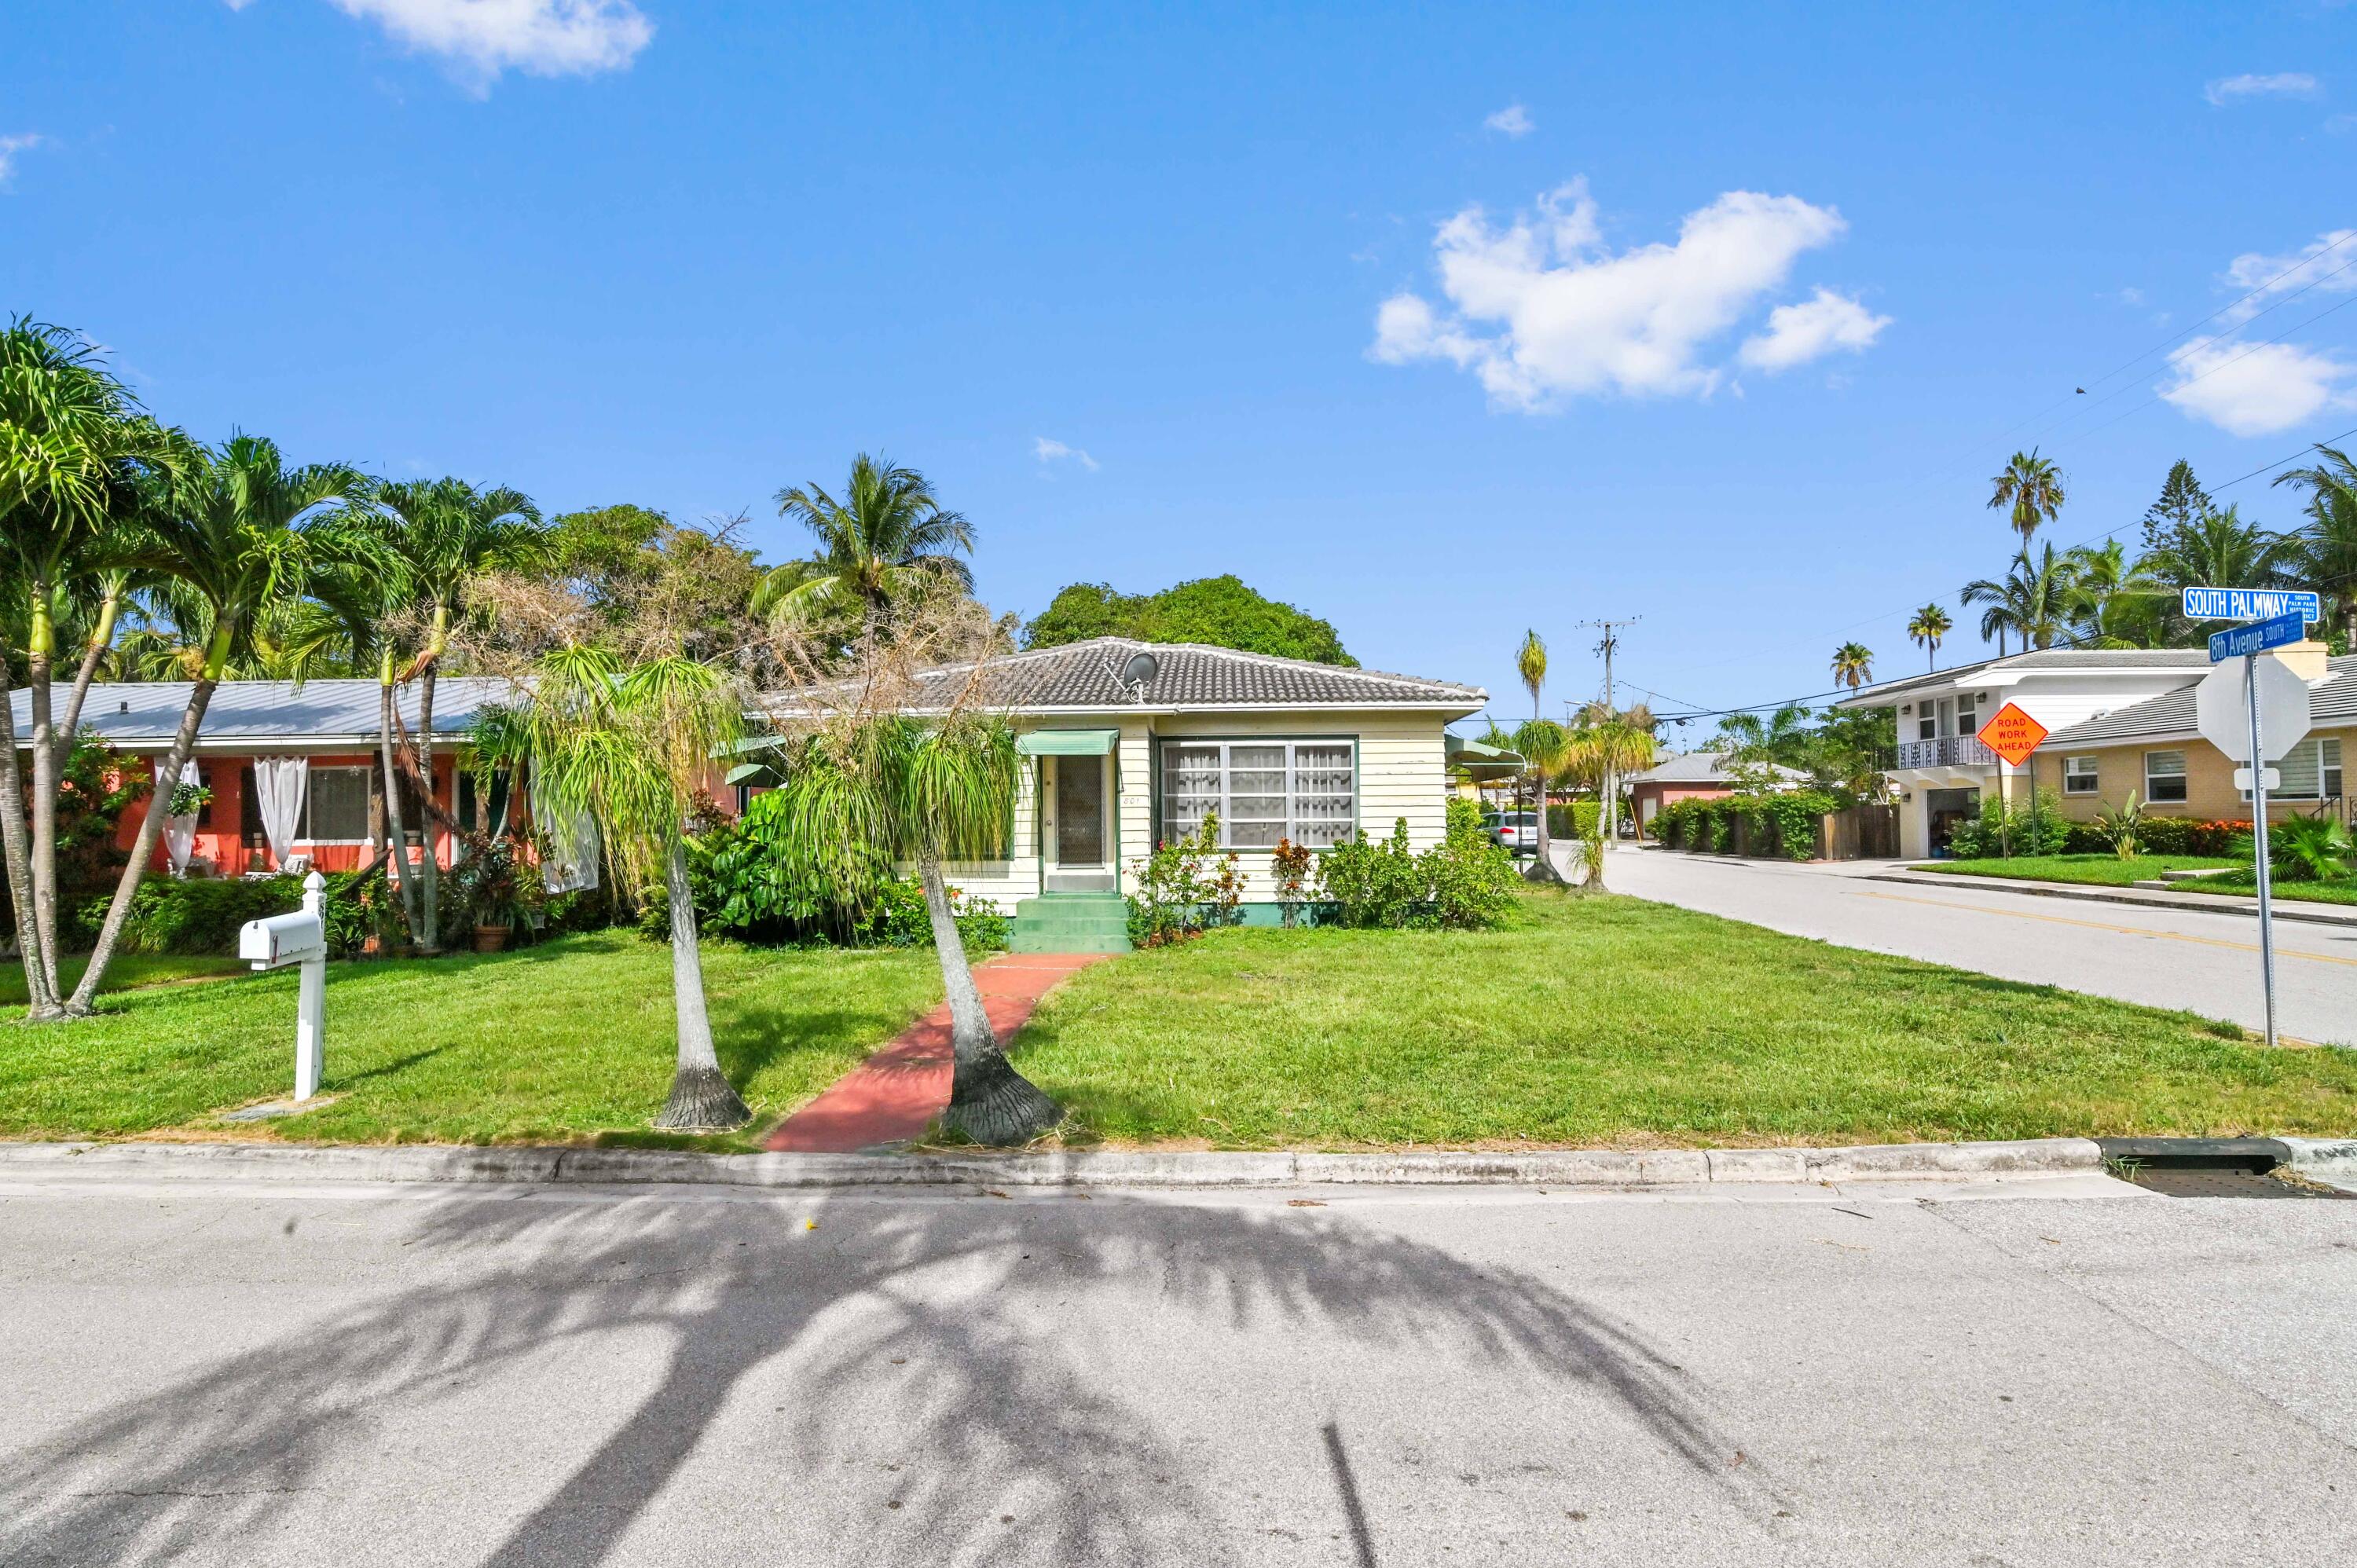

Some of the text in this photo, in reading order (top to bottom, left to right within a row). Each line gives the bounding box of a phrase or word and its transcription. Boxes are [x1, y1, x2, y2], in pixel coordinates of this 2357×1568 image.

[2187, 590, 2289, 617] SOUTH PALMWAY
[2211, 623, 2285, 661] 8th Avenue SOUTH
[1997, 718, 2026, 727] ROAD
[1998, 730, 2027, 739] WORK
[1997, 742, 2031, 751] AHEAD
